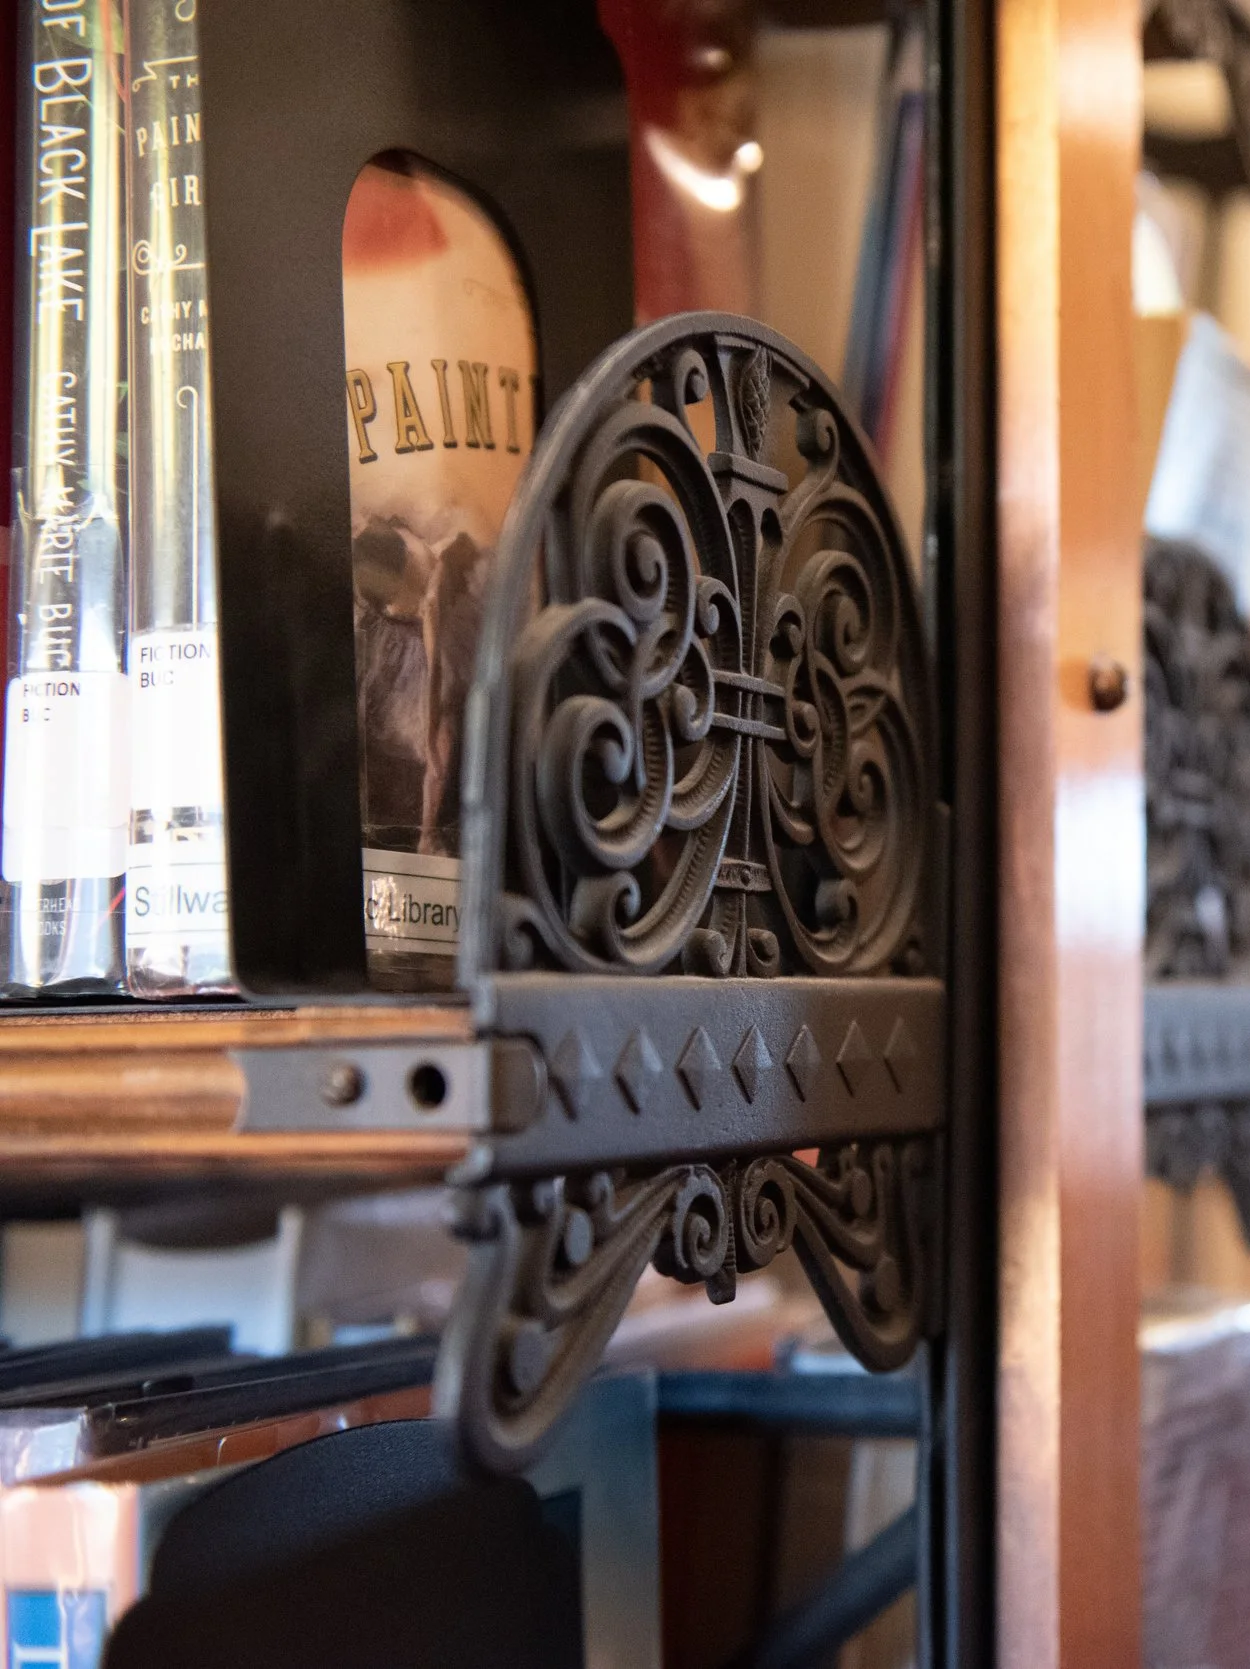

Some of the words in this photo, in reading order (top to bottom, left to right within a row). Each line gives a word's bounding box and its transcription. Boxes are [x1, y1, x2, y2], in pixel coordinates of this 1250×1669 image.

[32, 57, 93, 205] BLACK
[136, 112, 202, 157] PAIN
[29, 222, 89, 325] LAKE
[141, 300, 192, 325] CHY
[150, 331, 206, 354] CHA
[346, 358, 533, 465] PAINT
[140, 642, 212, 664] FICTION
[23, 681, 82, 698] FICTION
[140, 668, 174, 690] BUC
[22, 706, 52, 723] BC
[134, 884, 229, 918] Stillwa
[387, 890, 460, 933] Library
